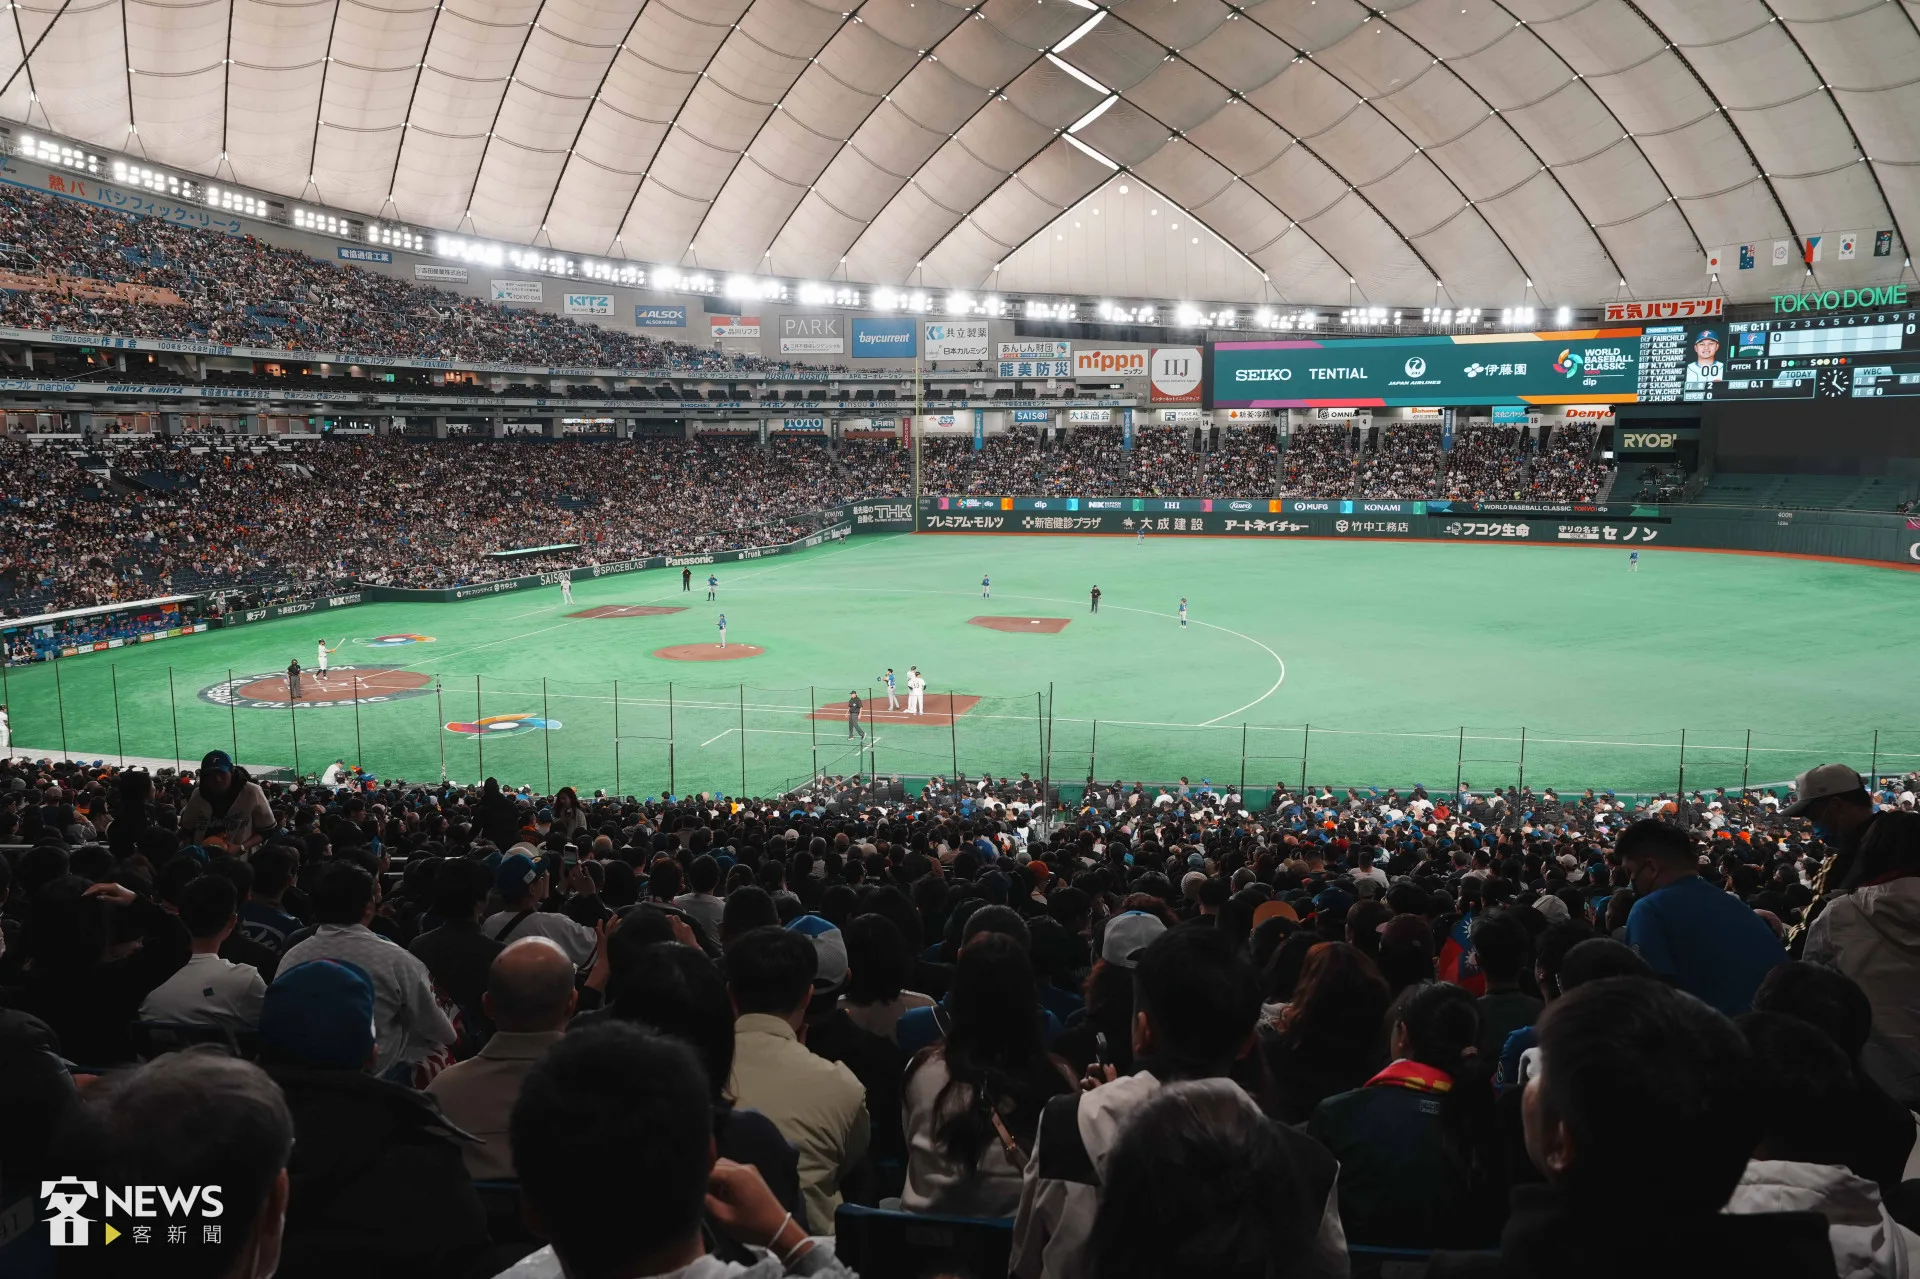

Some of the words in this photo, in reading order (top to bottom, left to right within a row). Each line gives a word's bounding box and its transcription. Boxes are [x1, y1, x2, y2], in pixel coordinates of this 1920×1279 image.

[97, 188, 242, 233] パシフィック・リーグ
[569, 295, 609, 307] KITZ
[1771, 291, 1841, 314] TOKYO
[1843, 284, 1907, 308] DOME
[647, 310, 683, 318] ALSOK
[1789, 321, 1796, 329] 2
[1804, 320, 1811, 328] 3
[1893, 313, 1900, 321] 9
[1908, 312, 1916, 320] R
[785, 319, 838, 335] PARK
[1730, 324, 1748, 332] TIME
[1750, 322, 1770, 332] 0:11
[1906, 323, 1916, 335] 0
[858, 331, 910, 345] baycurrent
[946, 328, 987, 338] 共立製薬
[1652, 334, 1685, 342] FAIRCHILD
[1773, 333, 1781, 342] 0
[943, 347, 988, 355] 日本カルミック
[1002, 343, 1053, 353] あんしん財団
[1585, 348, 1620, 356] WORLD
[1078, 351, 1143, 372] nippn
[1584, 355, 1634, 363] BASEBALL
[1755, 359, 1769, 370] 11
[1780, 360, 1788, 368] B
[999, 362, 1068, 377] 能美防災
[1163, 359, 1191, 377] IIJ
[1309, 367, 1368, 380] TENTIAL
[1484, 363, 1527, 376] 伊藤園
[1701, 365, 1719, 377] 00
[764, 372, 795, 380] DUSKIN
[799, 372, 829, 380] DUSKIN
[1235, 368, 1292, 382] SEIKO
[1582, 378, 1597, 386] dip
[1750, 380, 1764, 388] 0.1
[1795, 379, 1801, 387] 0
[1876, 387, 1883, 395] 0
[1070, 410, 1110, 420] 大塚商会
[1566, 409, 1614, 420] Denyo
[786, 419, 822, 428] TOTO
[1034, 501, 1047, 509] dip
[1164, 501, 1180, 509] IHI
[1306, 503, 1329, 511] MUFG
[1364, 503, 1401, 511] KONAMI
[874, 504, 912, 519] THK
[927, 516, 1004, 529] プレミアム・モルツ
[1035, 516, 1101, 529] 新宿健診プラザ
[1140, 517, 1204, 531] 大成建設
[1224, 519, 1310, 532] アートネイチャー
[1351, 520, 1409, 533] 竹中工務店
[1463, 522, 1530, 538] フコク生命
[1558, 525, 1600, 534] 守りの名手
[1602, 525, 1658, 541] セノン
[744, 550, 761, 559] Trunk
[665, 554, 714, 567] Panasonic
[600, 560, 648, 574] SPACEBLAST
[246, 610, 267, 622] 東テク
